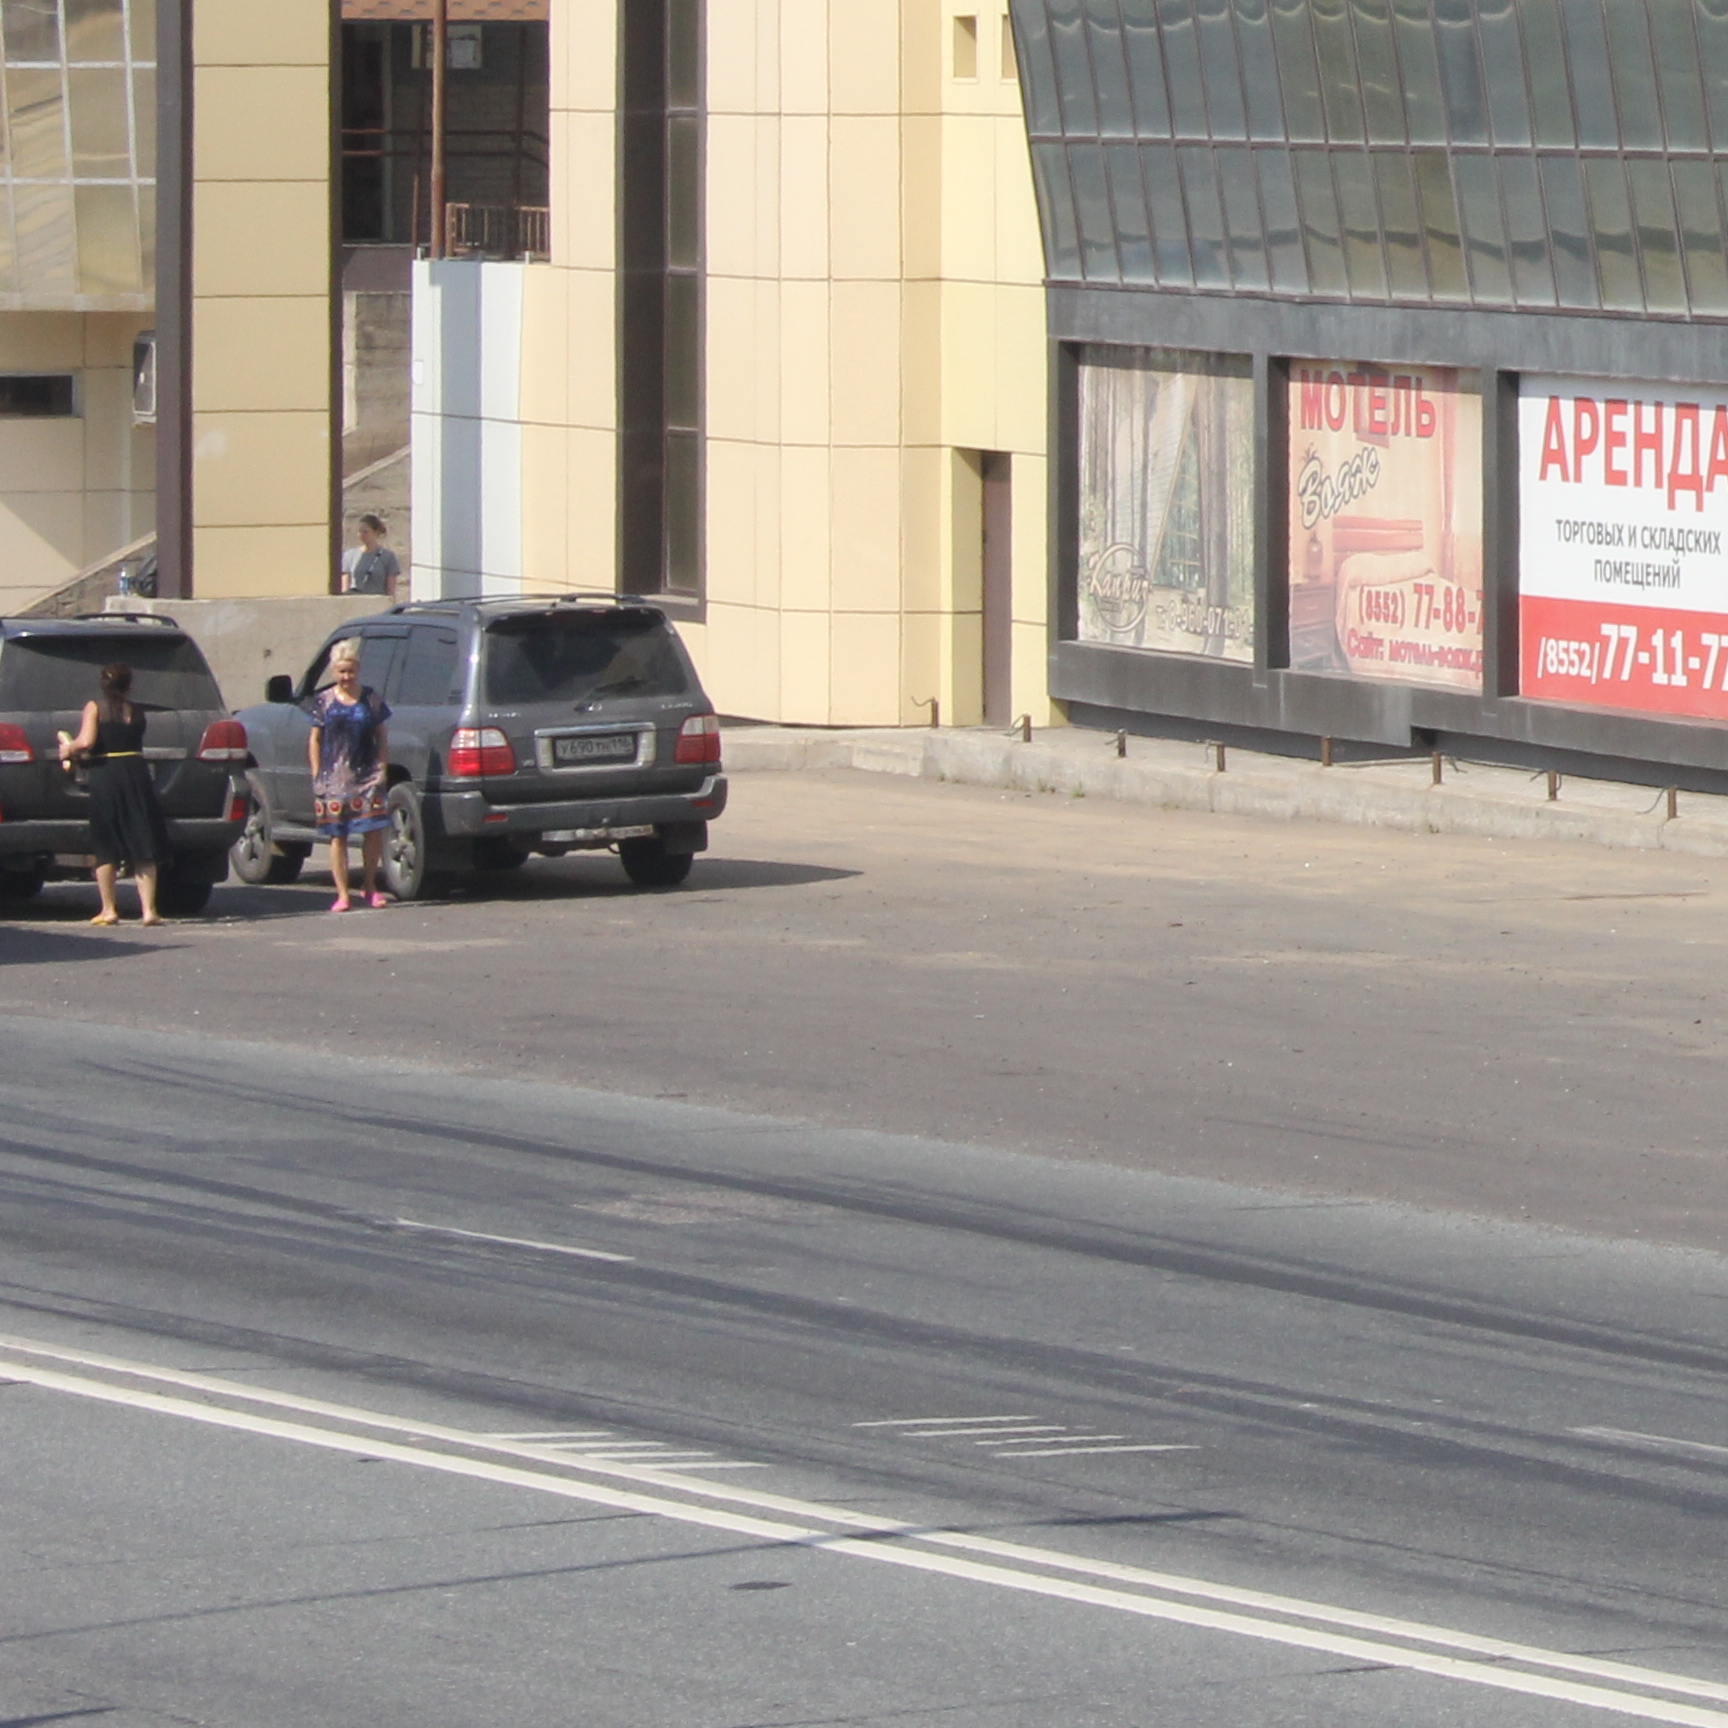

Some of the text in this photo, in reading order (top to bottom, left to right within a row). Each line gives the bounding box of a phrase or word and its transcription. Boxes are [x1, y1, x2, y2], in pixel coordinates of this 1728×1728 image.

[1301, 369, 1436, 438] МОТЕЛЬ
[1298, 446, 1381, 529] Вояж
[1556, 519, 1721, 557] ТОРГОВЫХ И СКЛАДСКИХ
[1594, 558, 1681, 591] ПОМЕЩЕНИЙ
[1359, 575, 1406, 629] (8552)
